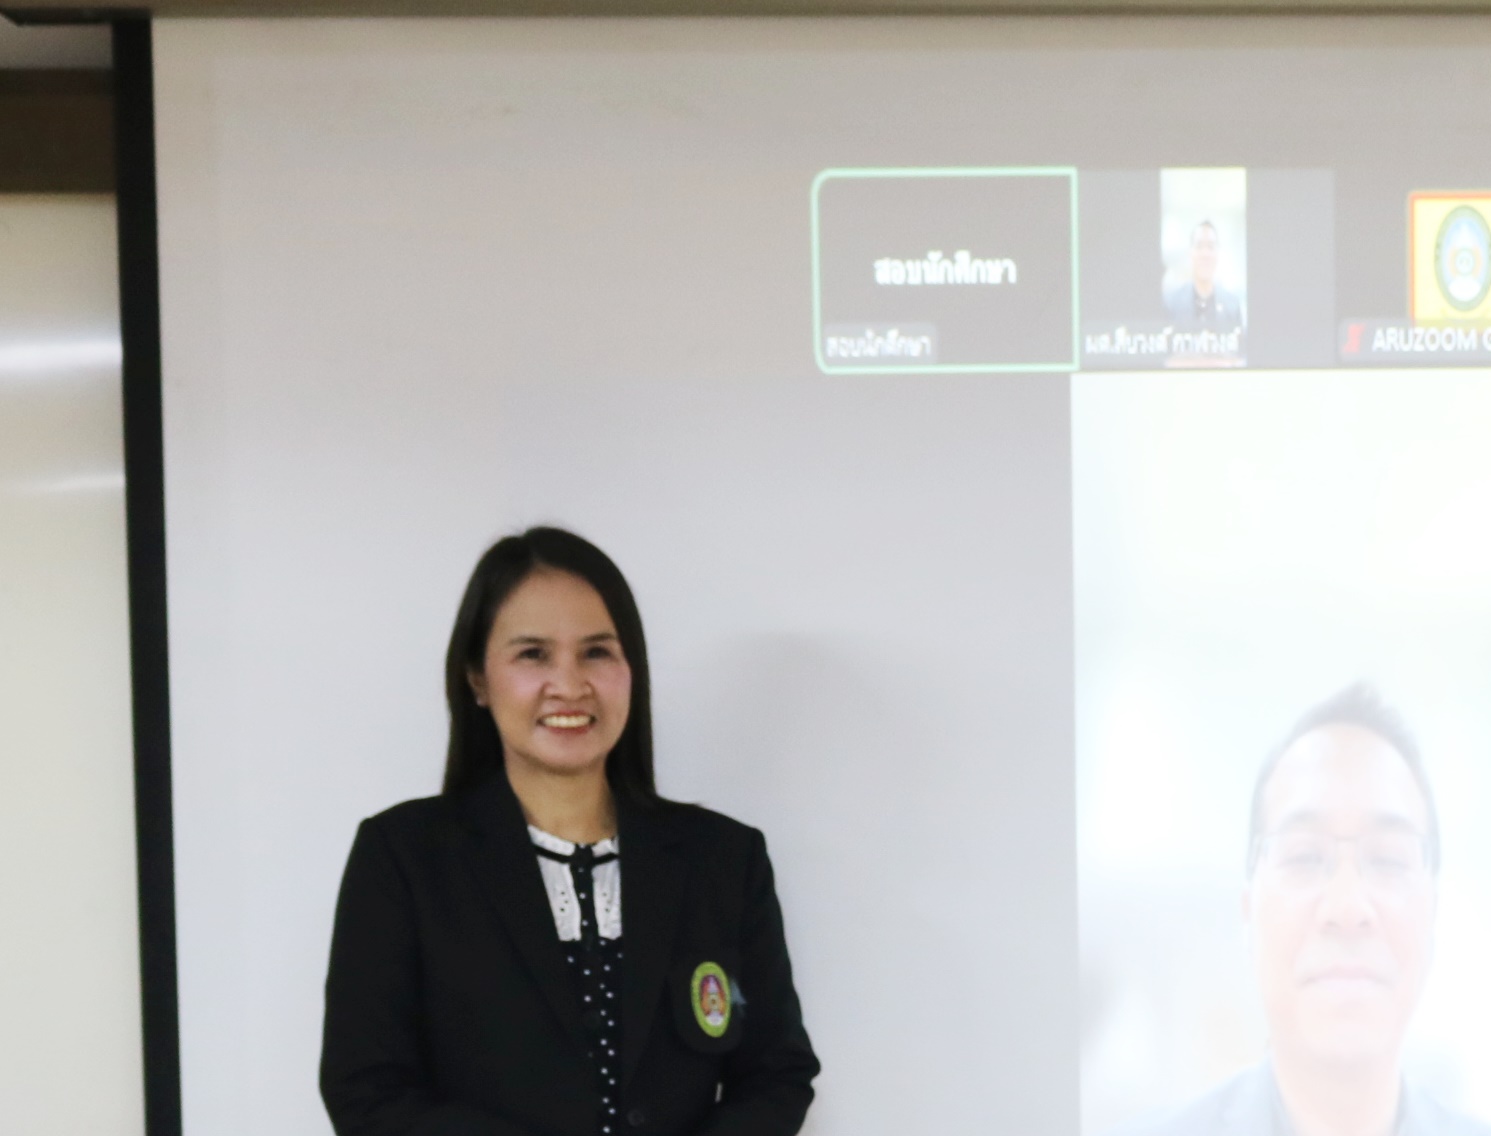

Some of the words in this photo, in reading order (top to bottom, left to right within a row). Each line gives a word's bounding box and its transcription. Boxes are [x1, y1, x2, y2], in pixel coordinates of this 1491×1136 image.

[873, 250, 1018, 286] สอบนักศึกษา
[1371, 327, 1478, 352] ARUZOOM
